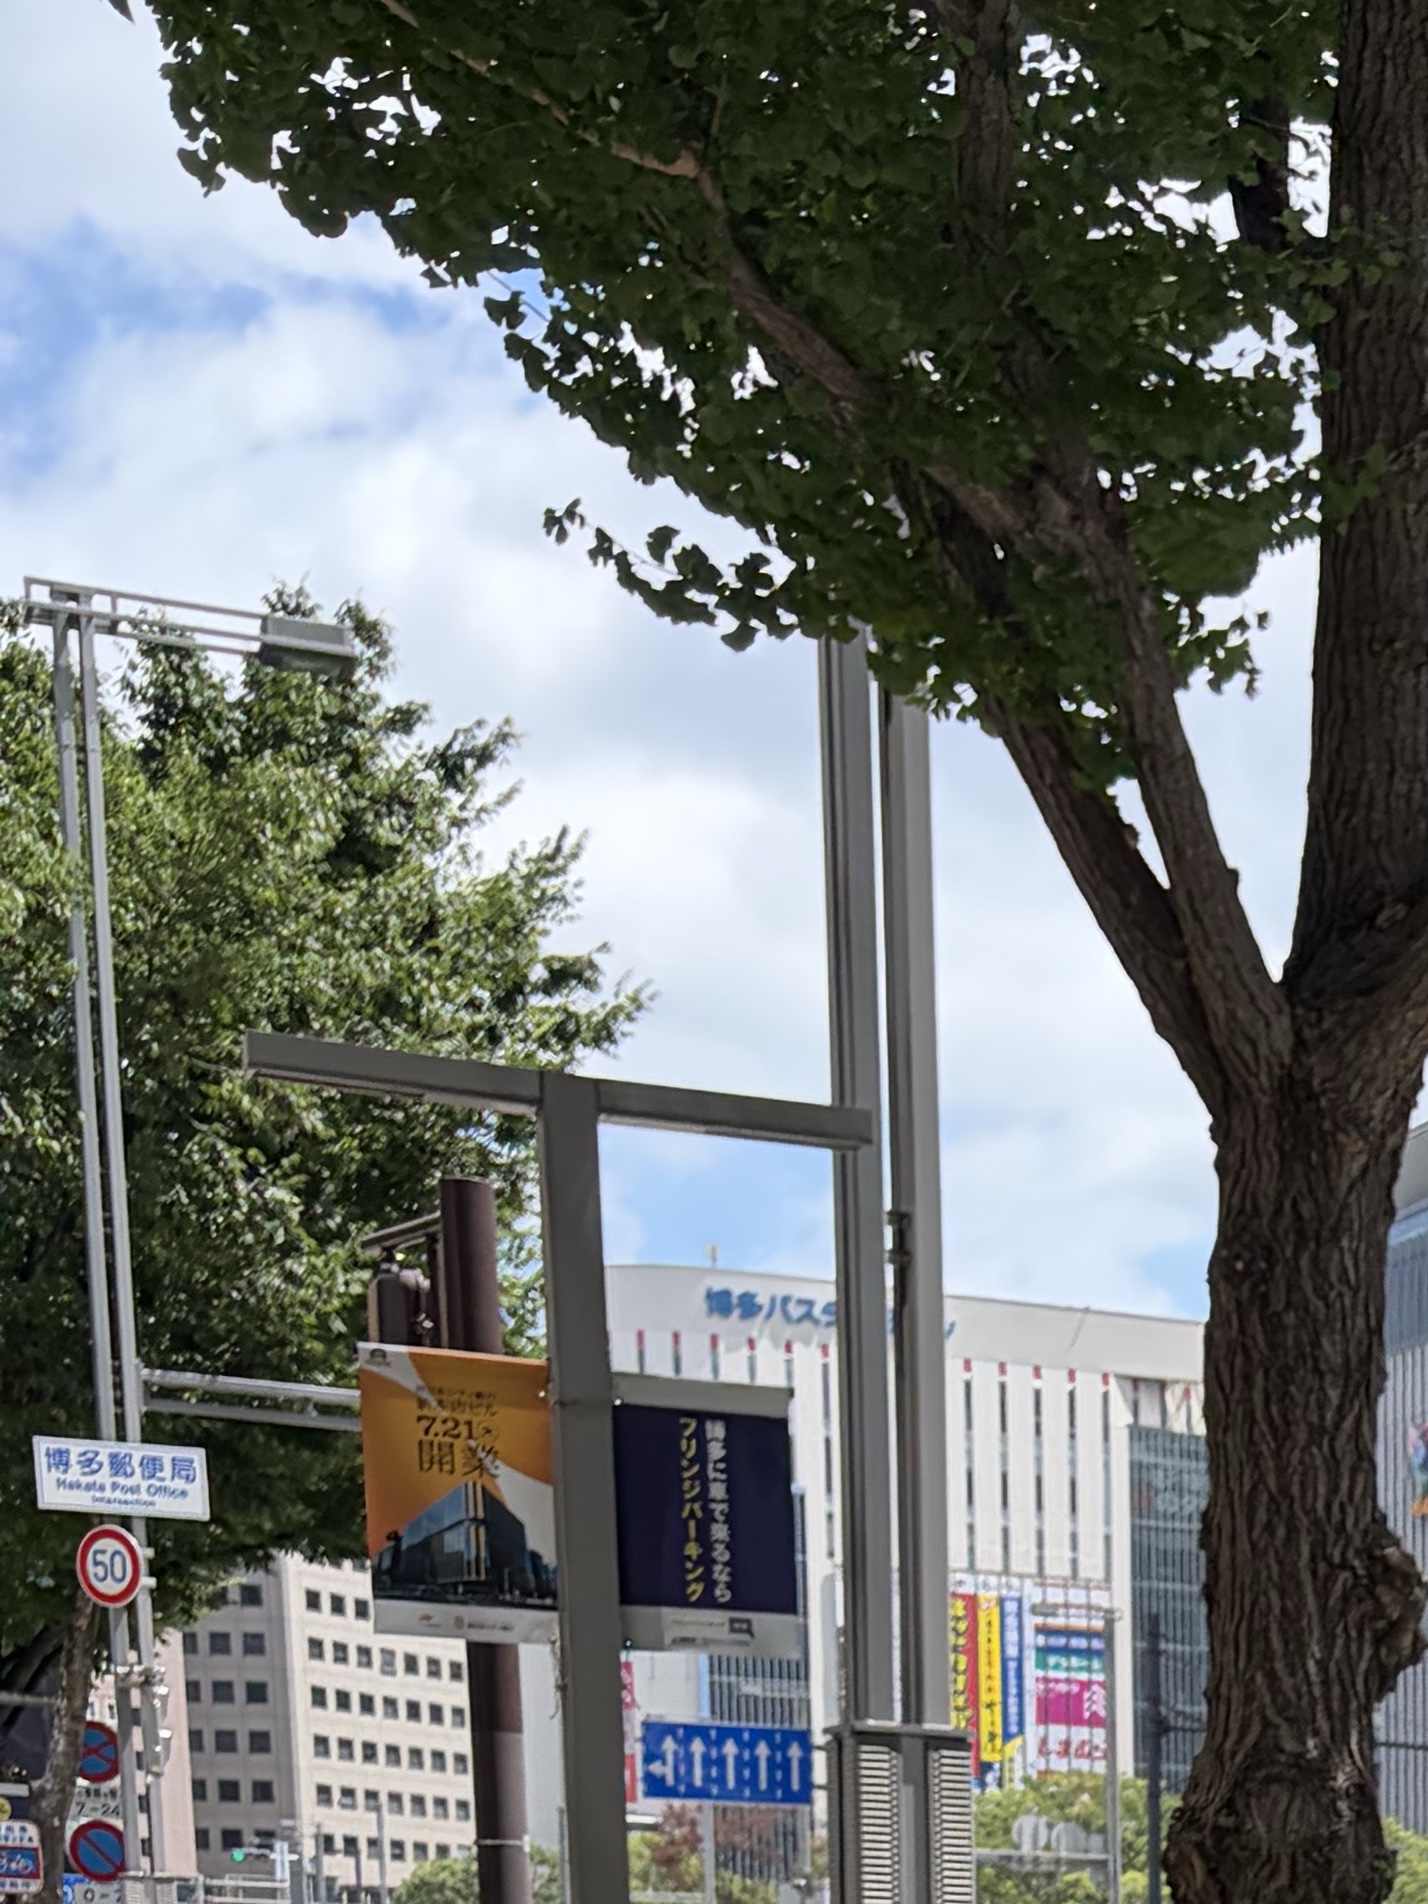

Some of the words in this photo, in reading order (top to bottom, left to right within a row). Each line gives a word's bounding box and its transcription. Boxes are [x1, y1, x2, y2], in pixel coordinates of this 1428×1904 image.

[44, 1446, 197, 1485] 博多郵便局
[92, 1549, 128, 1585] 50
